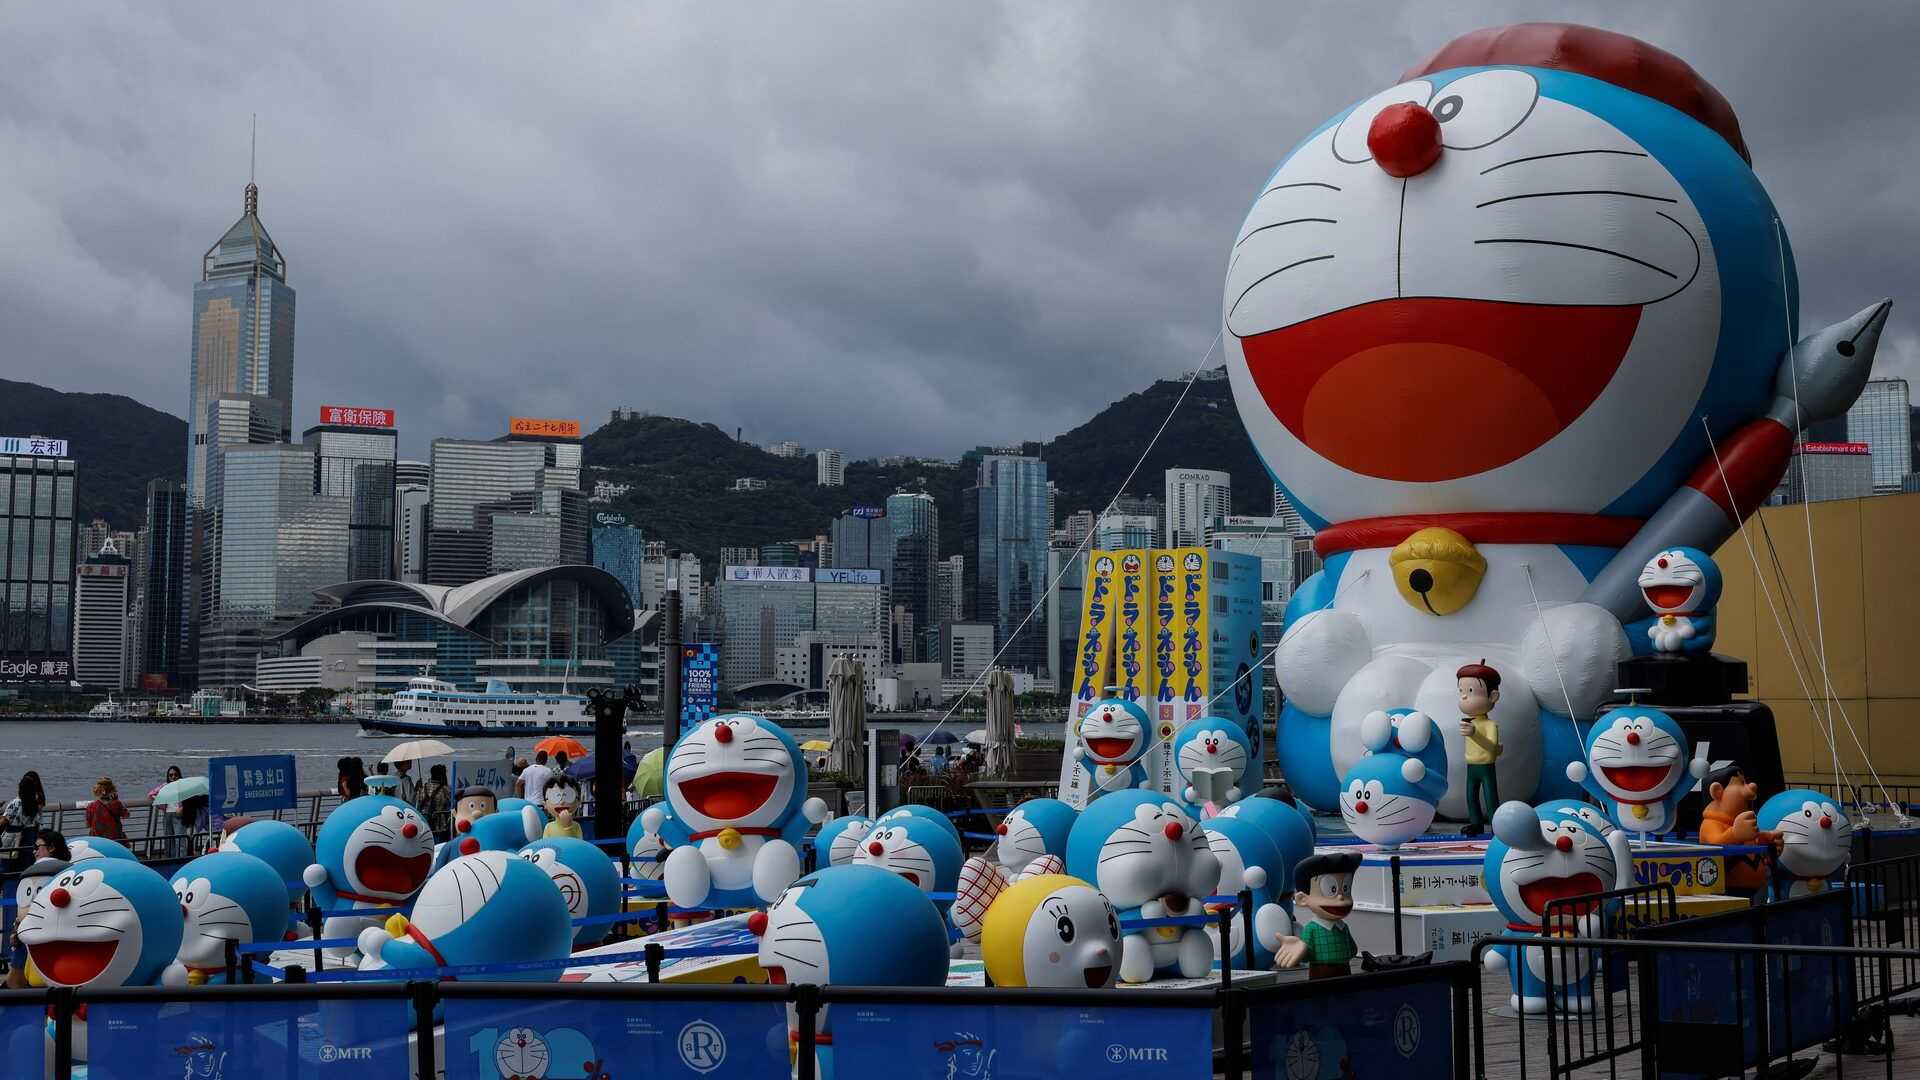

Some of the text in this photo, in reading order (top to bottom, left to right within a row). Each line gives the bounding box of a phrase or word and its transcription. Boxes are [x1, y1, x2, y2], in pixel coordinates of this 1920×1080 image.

[329, 408, 386, 425] 富衛保險
[30, 440, 62, 455] 宏利
[1179, 473, 1210, 481] CONRAD
[596, 512, 625, 523] Carlsberg
[752, 567, 801, 581] 華人置業
[1157, 575, 1175, 702] ドラえもん
[1183, 574, 1202, 702] ドラえもん
[0, 659, 69, 678] Eagle 鷹君
[688, 669, 712, 678] 100%
[243, 767, 285, 786] 緊急出口
[475, 767, 497, 786] 出口
[339, 1047, 372, 1060] MTR
[1128, 1047, 1168, 1061] MTR
